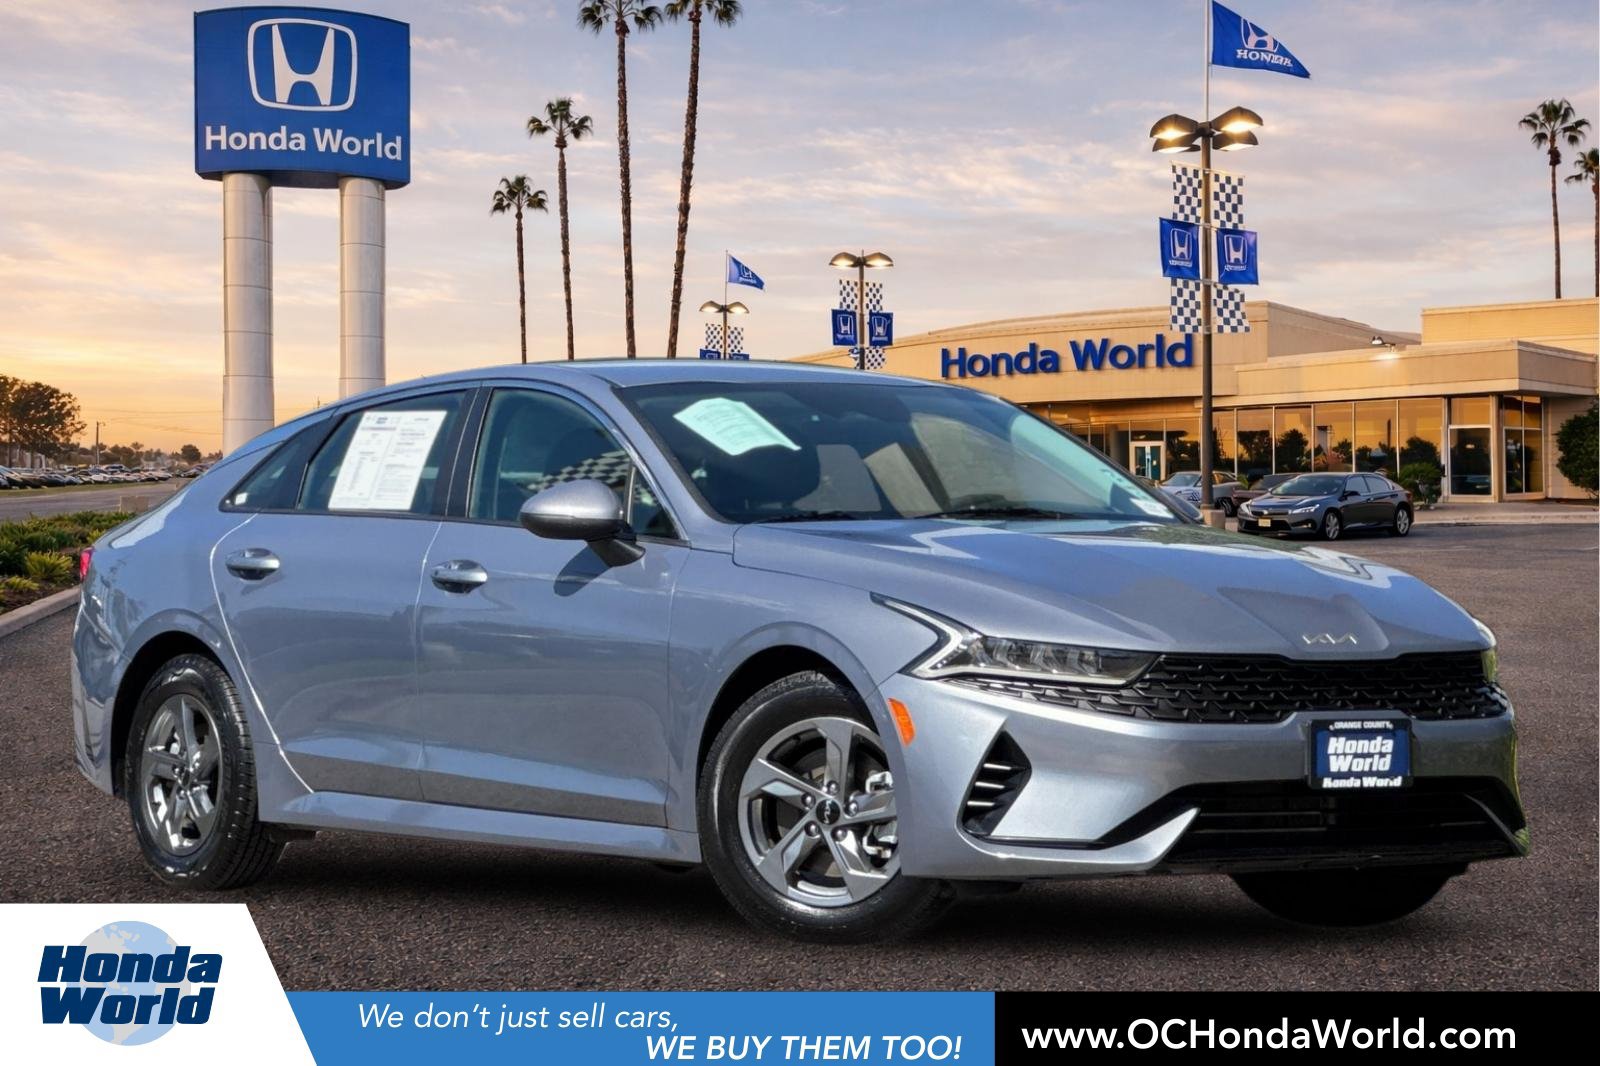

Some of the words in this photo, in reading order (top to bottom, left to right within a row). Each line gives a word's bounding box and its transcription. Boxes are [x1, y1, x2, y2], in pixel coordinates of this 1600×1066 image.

[205, 125, 306, 151] Honda
[313, 128, 402, 161] World
[941, 343, 1060, 377] Honda
[1070, 333, 1194, 370] World
[1334, 721, 1362, 730] ORANGE
[1363, 720, 1391, 730] COUNTY
[1327, 735, 1394, 755] Honda
[1329, 754, 1392, 773] World
